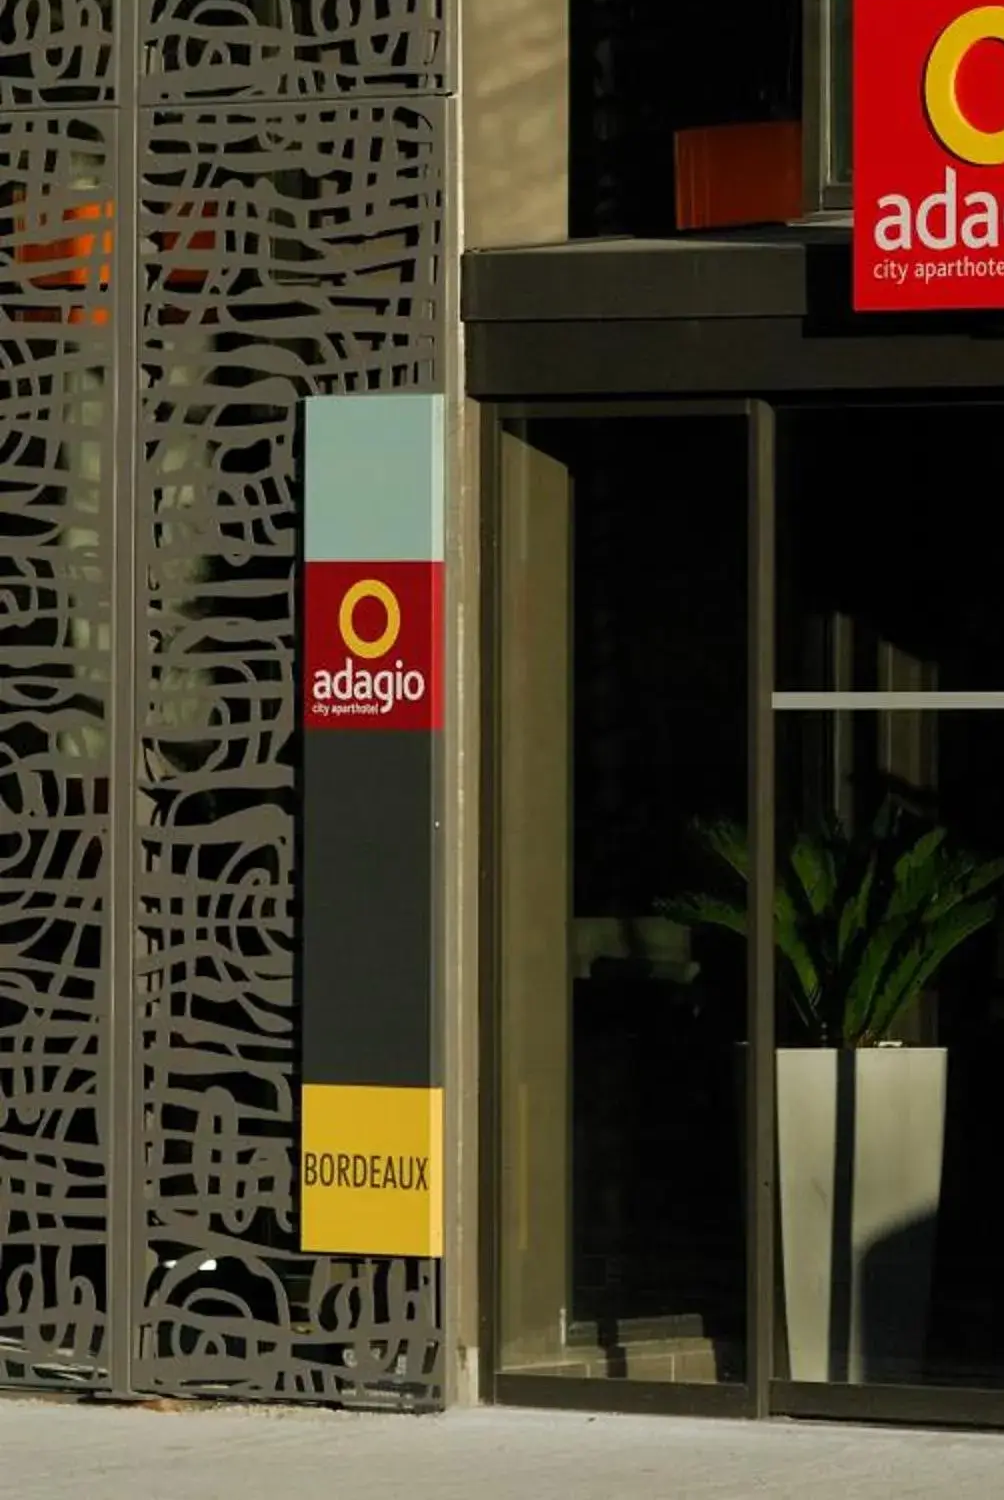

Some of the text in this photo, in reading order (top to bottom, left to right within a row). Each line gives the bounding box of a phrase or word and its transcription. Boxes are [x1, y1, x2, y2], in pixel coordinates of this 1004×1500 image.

[873, 257, 909, 285] city
[312, 656, 426, 714] adagio
[311, 702, 379, 717] city aparthotel
[304, 1152, 429, 1191] BORDEAUX
